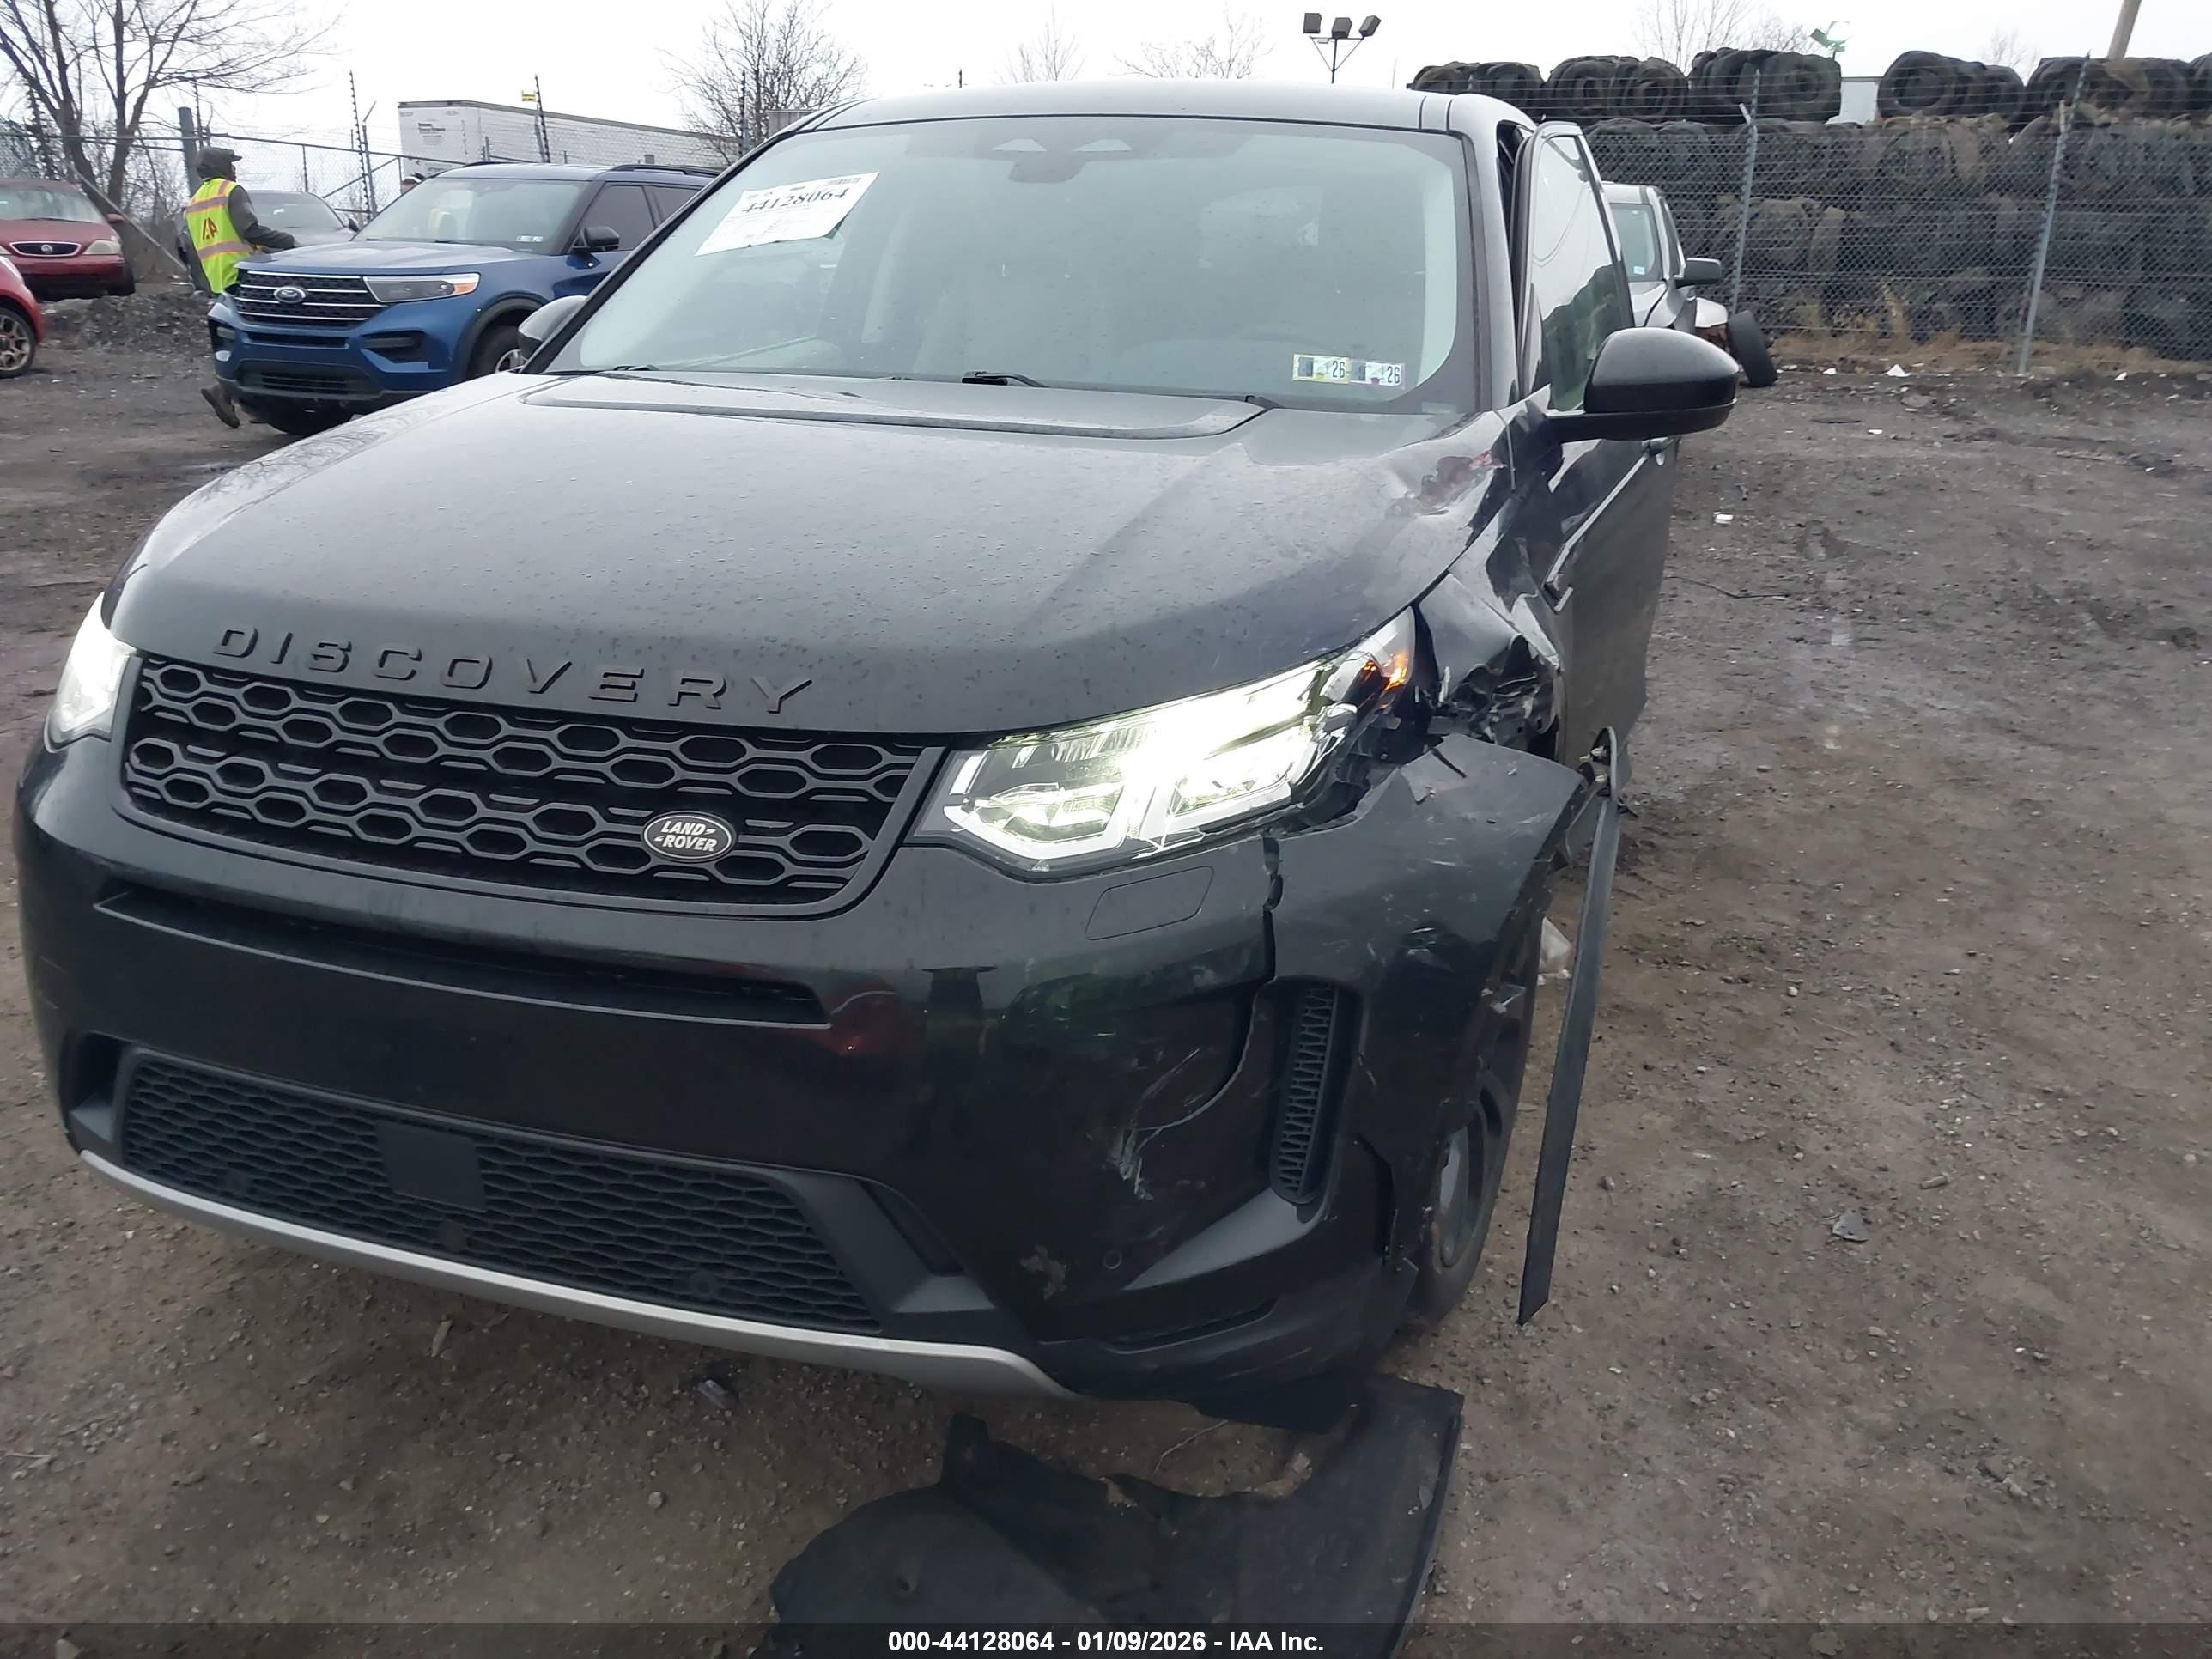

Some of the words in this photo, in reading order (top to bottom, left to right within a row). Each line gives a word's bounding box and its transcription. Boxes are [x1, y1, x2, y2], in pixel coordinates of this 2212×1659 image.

[742, 186, 850, 213] 44128064
[1332, 360, 1346, 379] 26
[1387, 365, 1401, 384] 26
[213, 626, 812, 714] DISCOVERY
